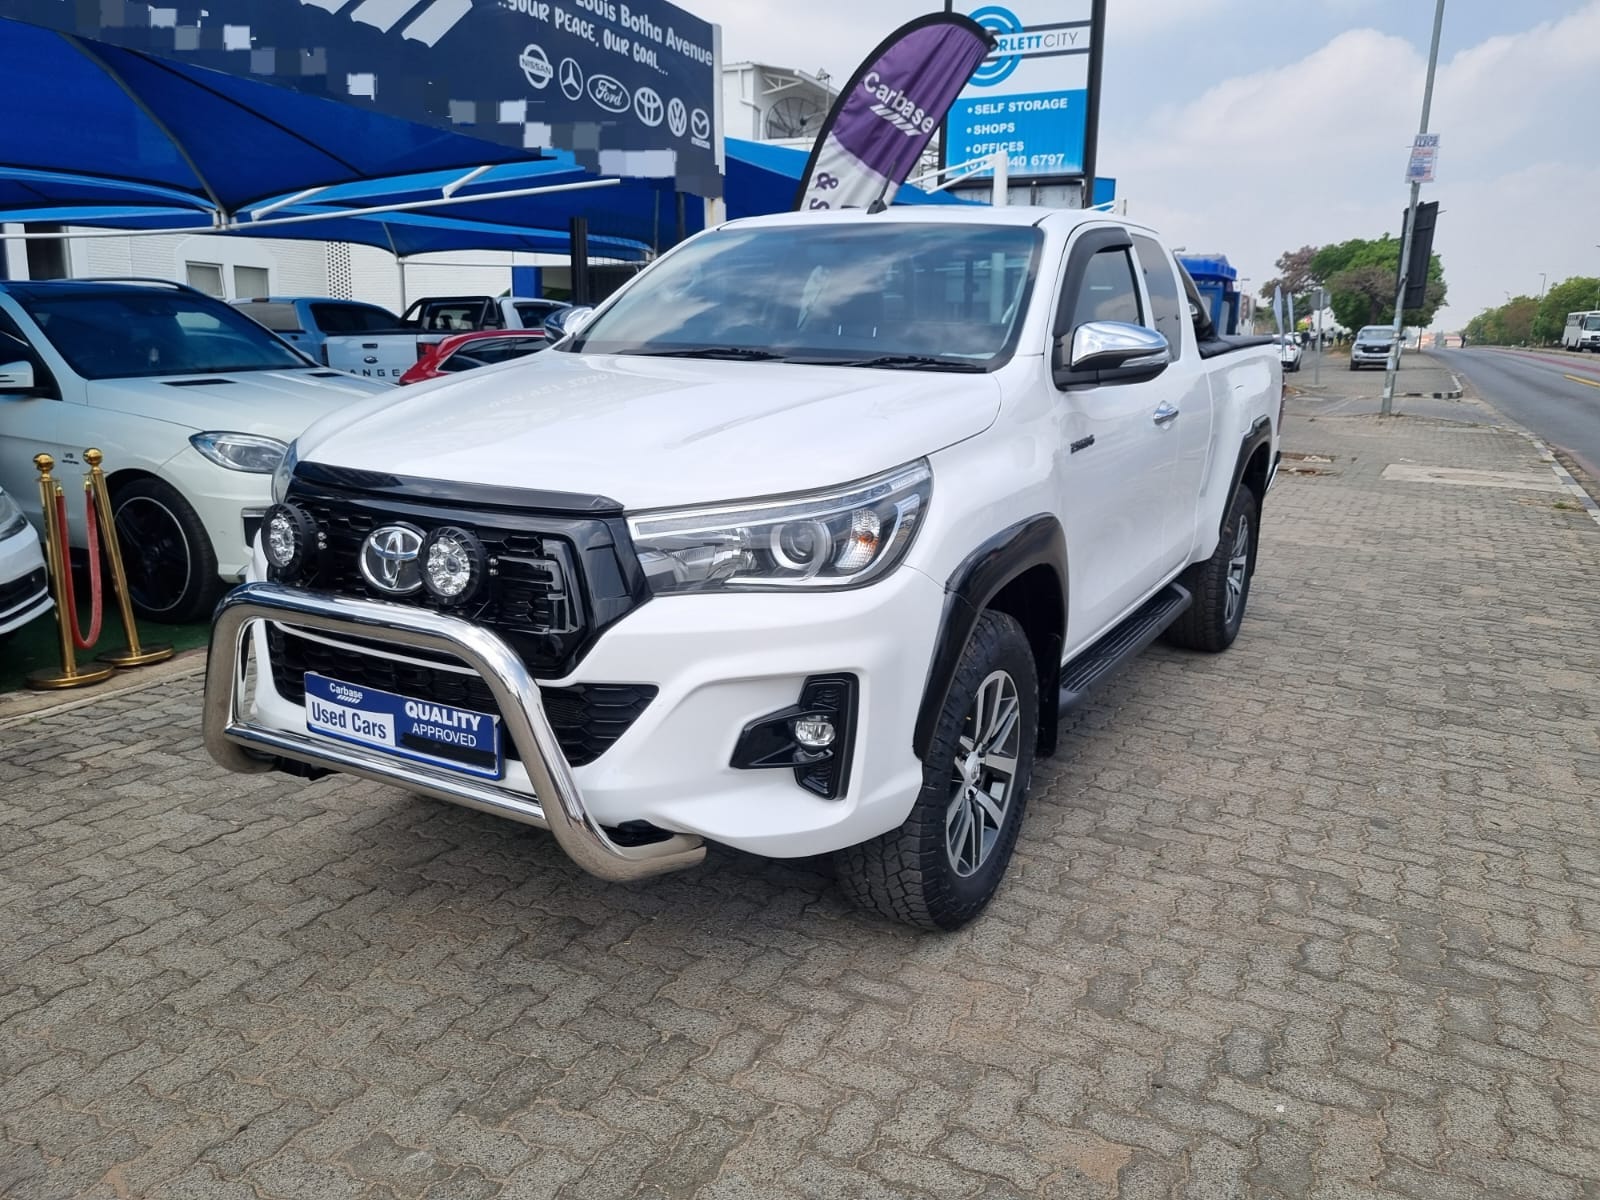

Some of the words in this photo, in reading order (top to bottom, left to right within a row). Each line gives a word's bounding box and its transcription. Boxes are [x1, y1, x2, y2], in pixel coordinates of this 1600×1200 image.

[575, 0, 617, 21] ouis
[620, 4, 662, 43] Botha
[666, 27, 713, 66] Avenue
[603, 29, 629, 56] OUR
[520, 57, 552, 76] NISSAN
[596, 80, 623, 106] Ford
[864, 72, 934, 133] Carbase
[974, 103, 1005, 115] SELF
[1008, 98, 1068, 112] STORAGE
[973, 122, 1015, 135] SHOPS
[972, 141, 1025, 154] OFFICES
[1031, 153, 1065, 166] 6797
[329, 683, 363, 699] Carbase
[312, 701, 347, 729] Used
[352, 712, 387, 739] Cars
[405, 701, 481, 731] QUALITY
[412, 722, 477, 747] APPROVED
